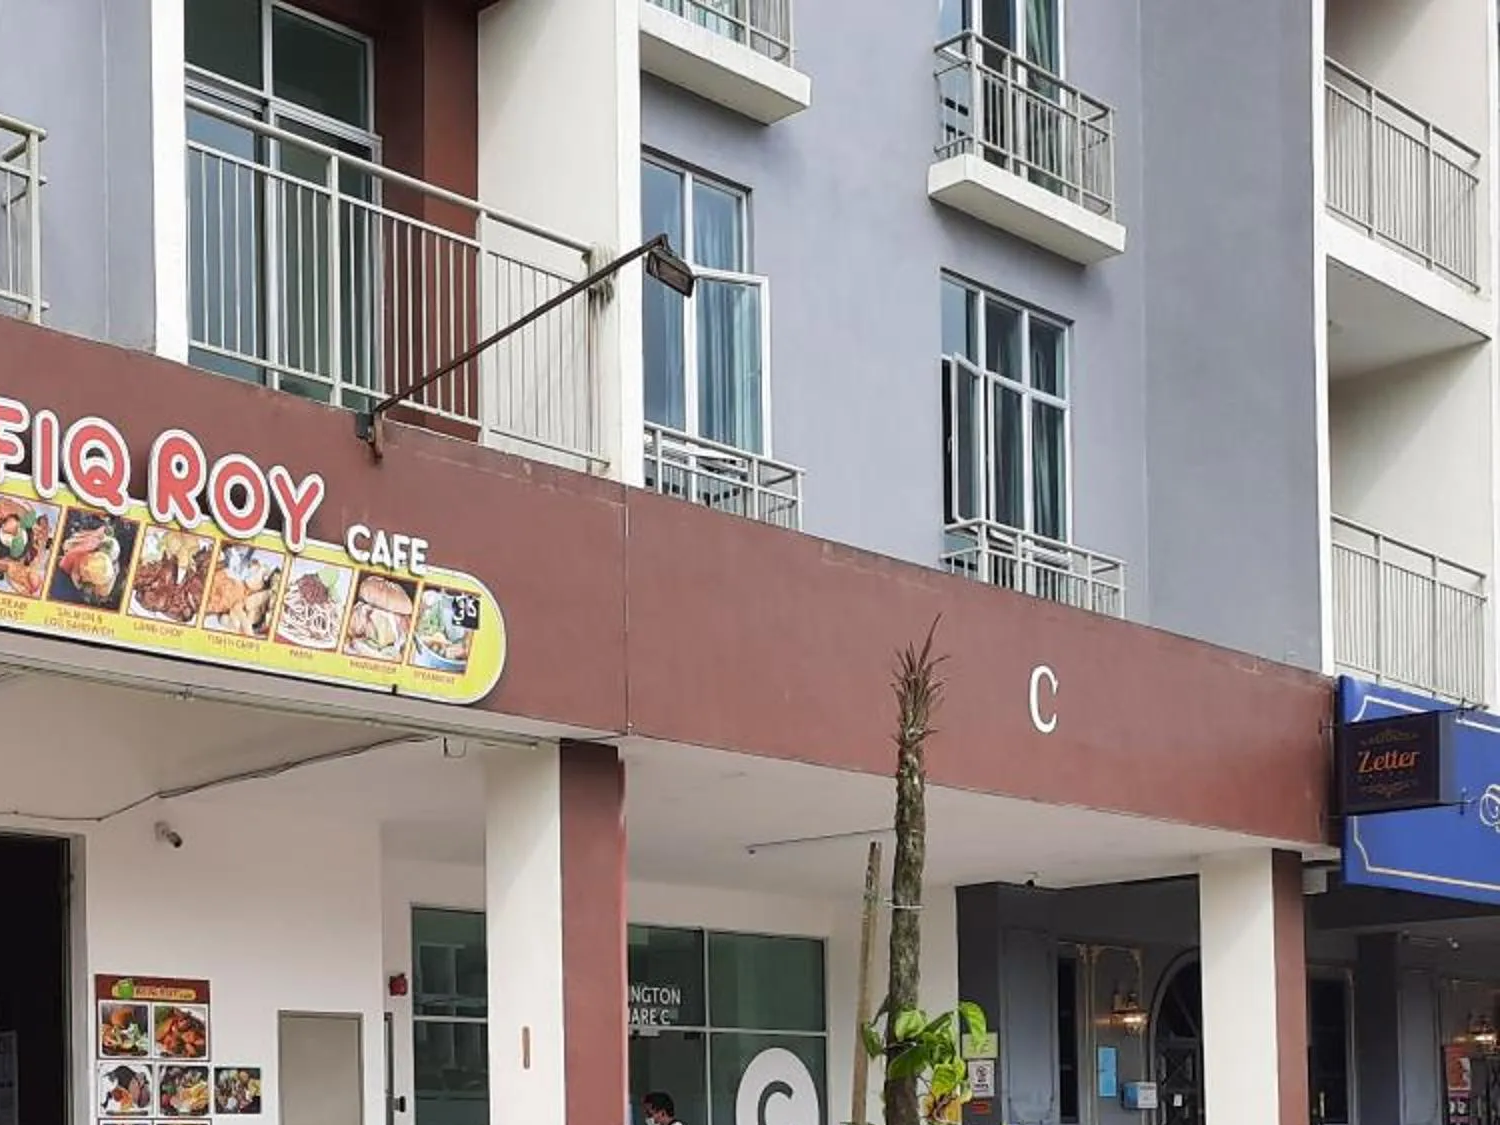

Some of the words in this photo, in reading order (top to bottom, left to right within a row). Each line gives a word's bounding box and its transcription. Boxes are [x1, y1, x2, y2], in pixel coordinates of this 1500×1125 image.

[148, 429, 325, 553] ROY
[346, 524, 429, 575] CAFE
[1028, 664, 1059, 734] C
[1357, 750, 1420, 773] Zetter
[628, 1007, 657, 1025] ARE
